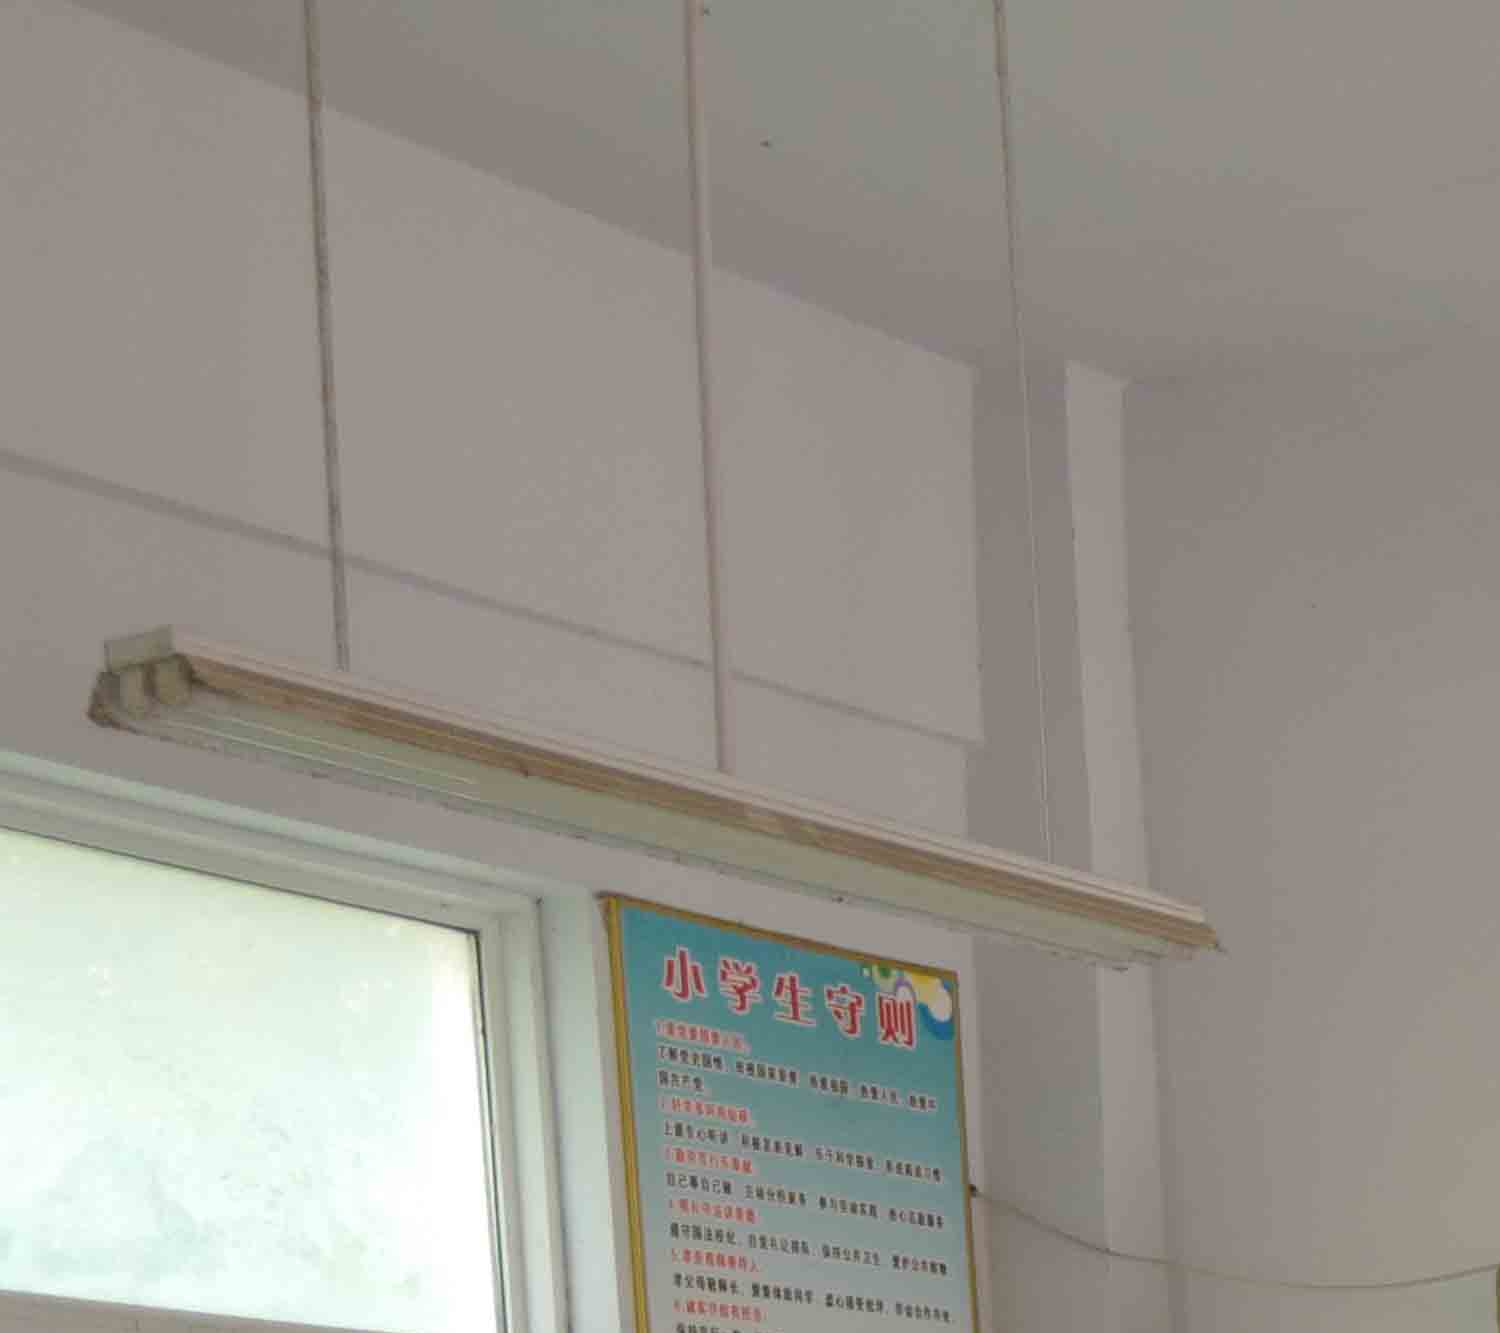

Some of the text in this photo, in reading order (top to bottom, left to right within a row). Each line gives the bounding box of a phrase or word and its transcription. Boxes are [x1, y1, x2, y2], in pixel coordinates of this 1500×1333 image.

[662, 946, 917, 1049] 小学生守则
